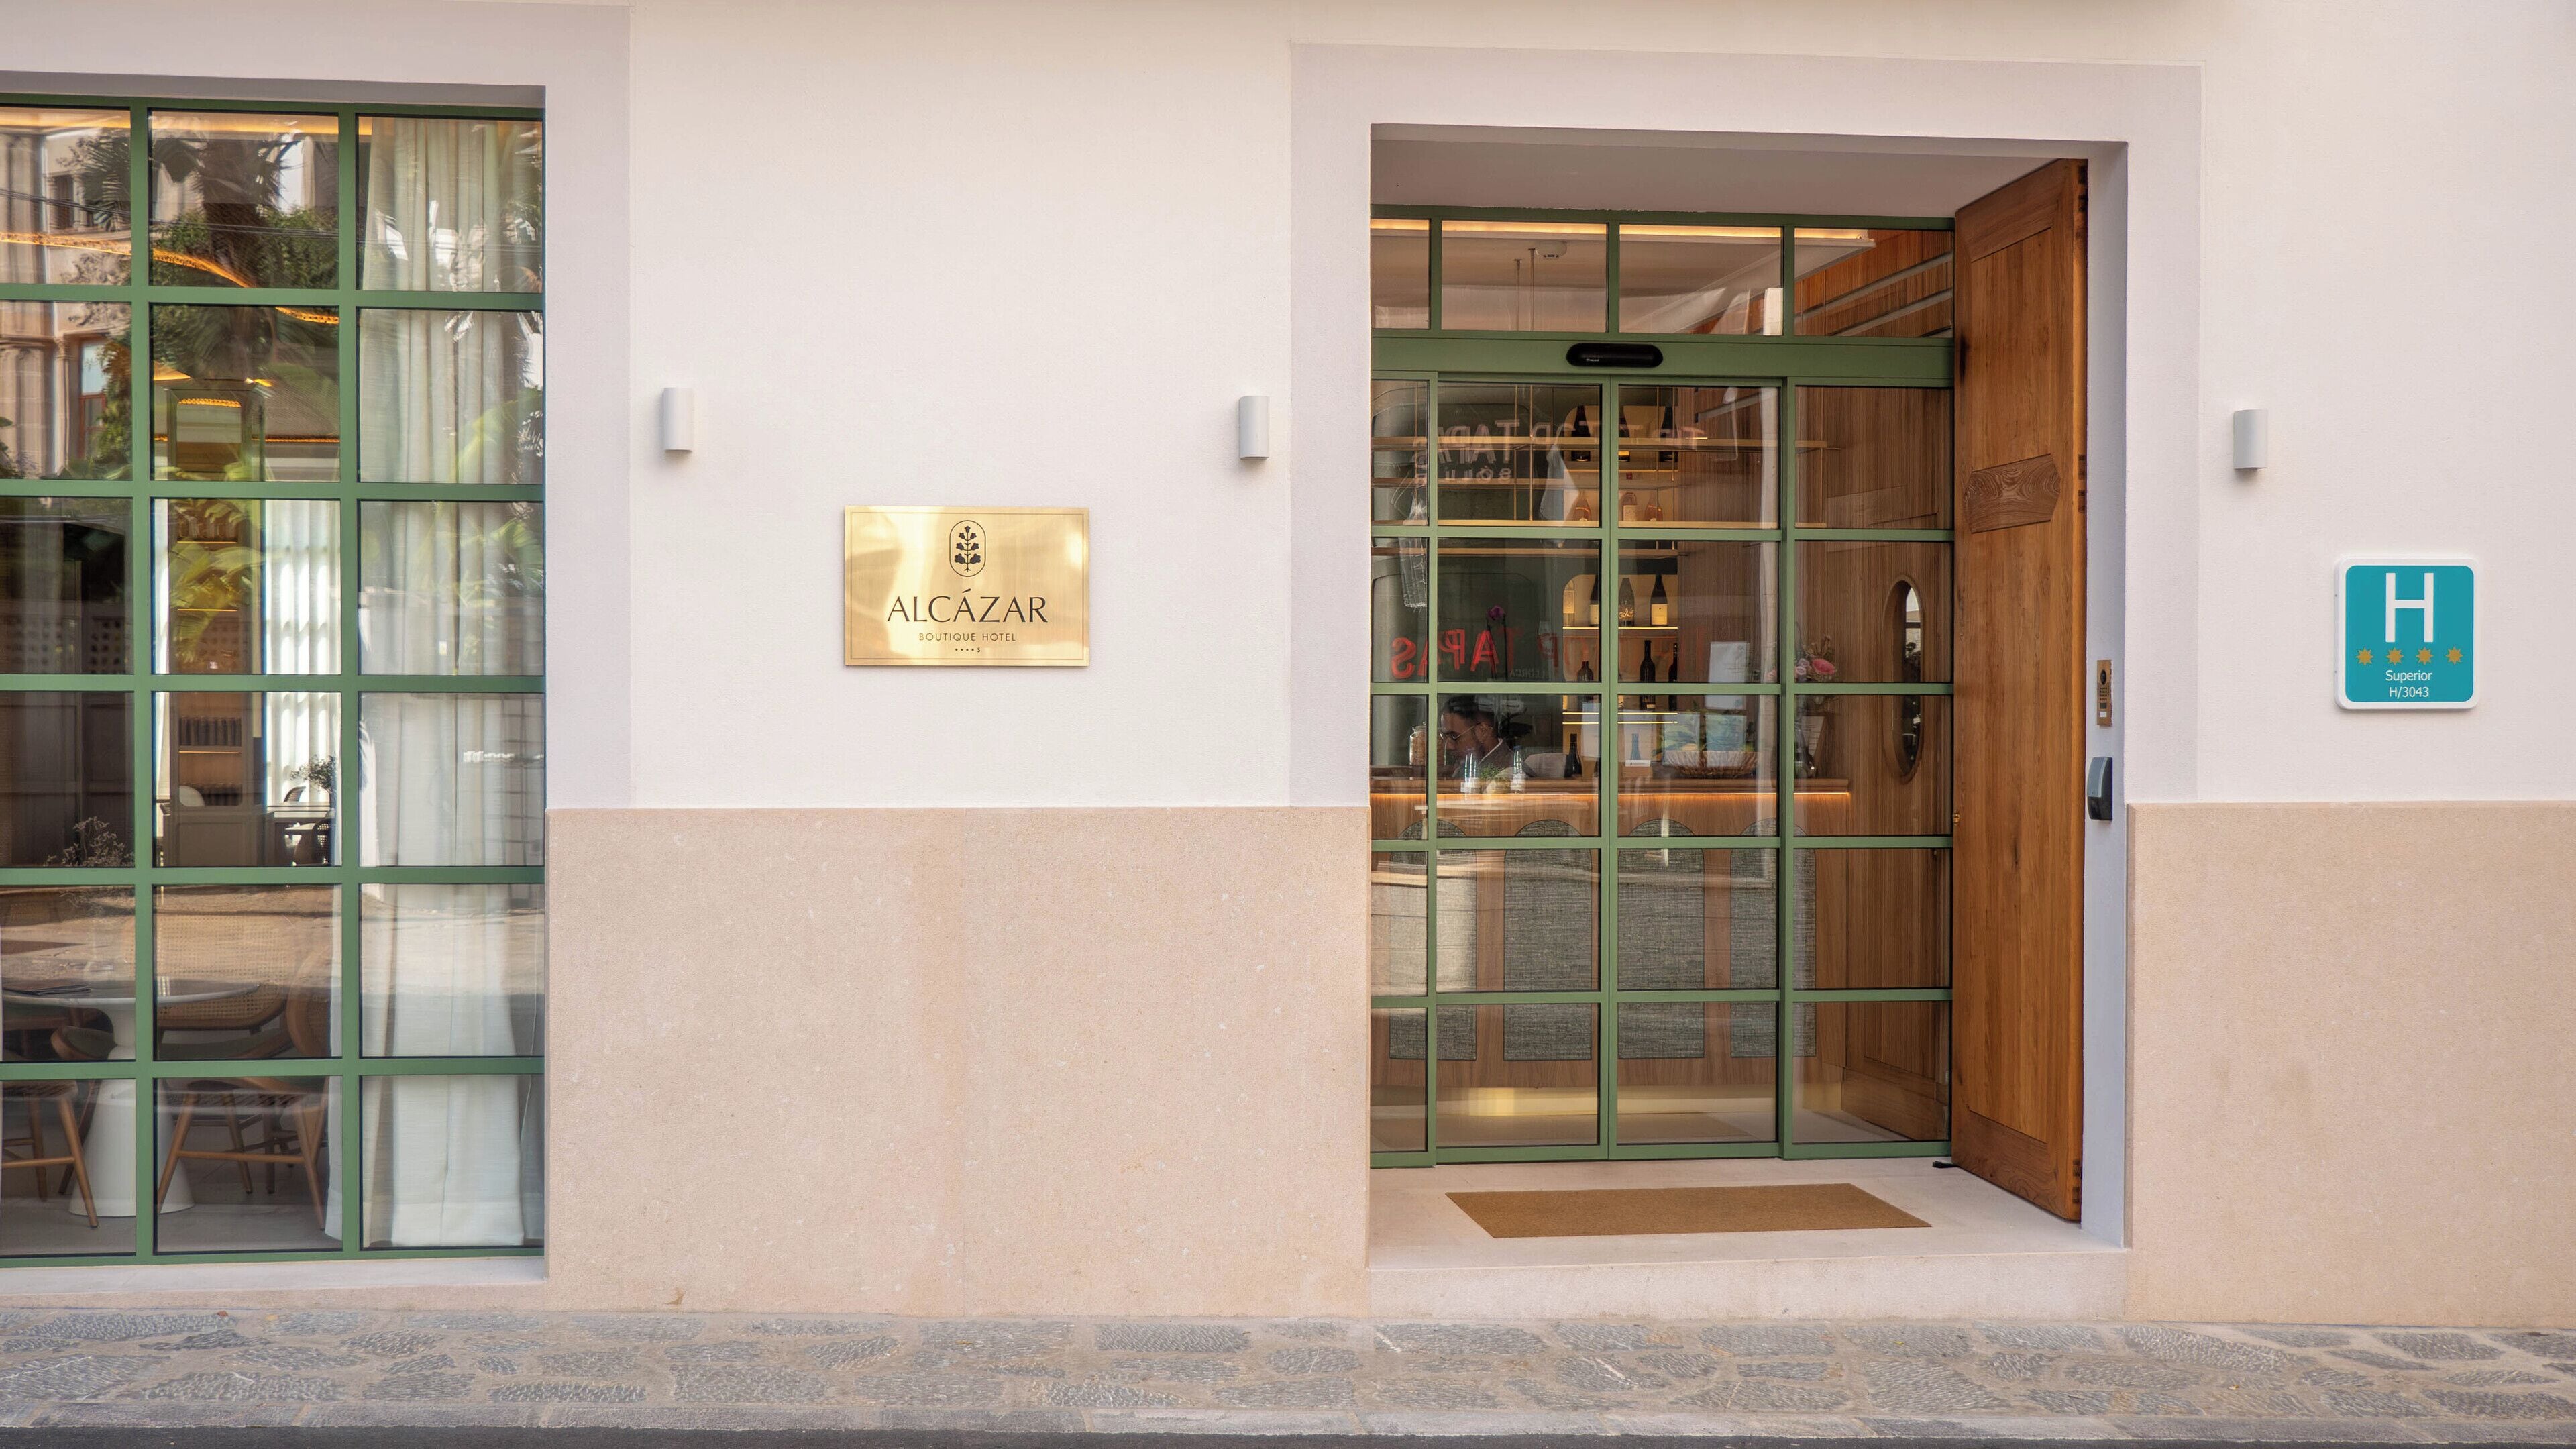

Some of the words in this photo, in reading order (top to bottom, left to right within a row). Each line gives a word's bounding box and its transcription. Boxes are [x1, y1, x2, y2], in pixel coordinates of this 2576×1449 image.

[886, 588, 1049, 623] ALCÁZAR
[2385, 572, 2434, 643] H
[918, 633, 977, 641] BOUTIQUE
[982, 633, 1016, 641] HOTEL
[2385, 669, 2433, 683] Superior
[2389, 686, 2430, 699] H/3043
